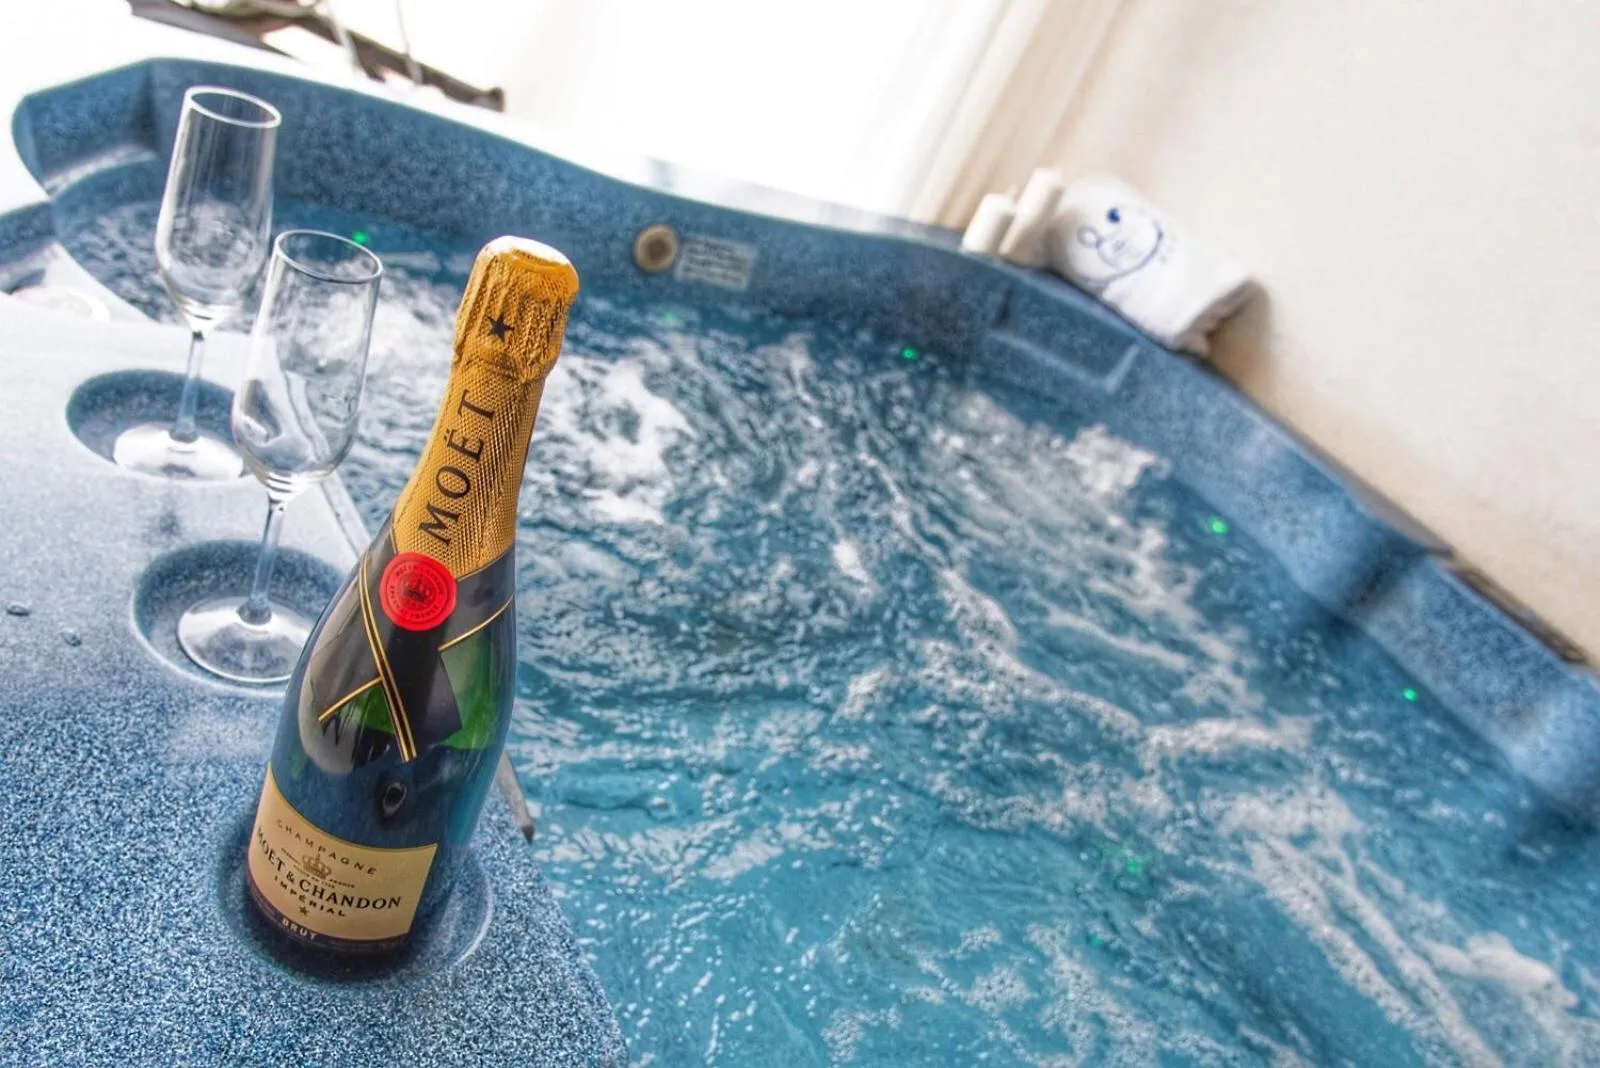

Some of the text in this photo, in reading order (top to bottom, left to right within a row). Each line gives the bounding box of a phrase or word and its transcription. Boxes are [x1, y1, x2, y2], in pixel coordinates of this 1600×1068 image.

[418, 389, 495, 547] MOËT
[276, 819, 377, 875] CHAMPAGNE
[286, 870, 295, 883] &
[299, 878, 402, 910] CHANDON
[282, 917, 317, 940] BRUT
